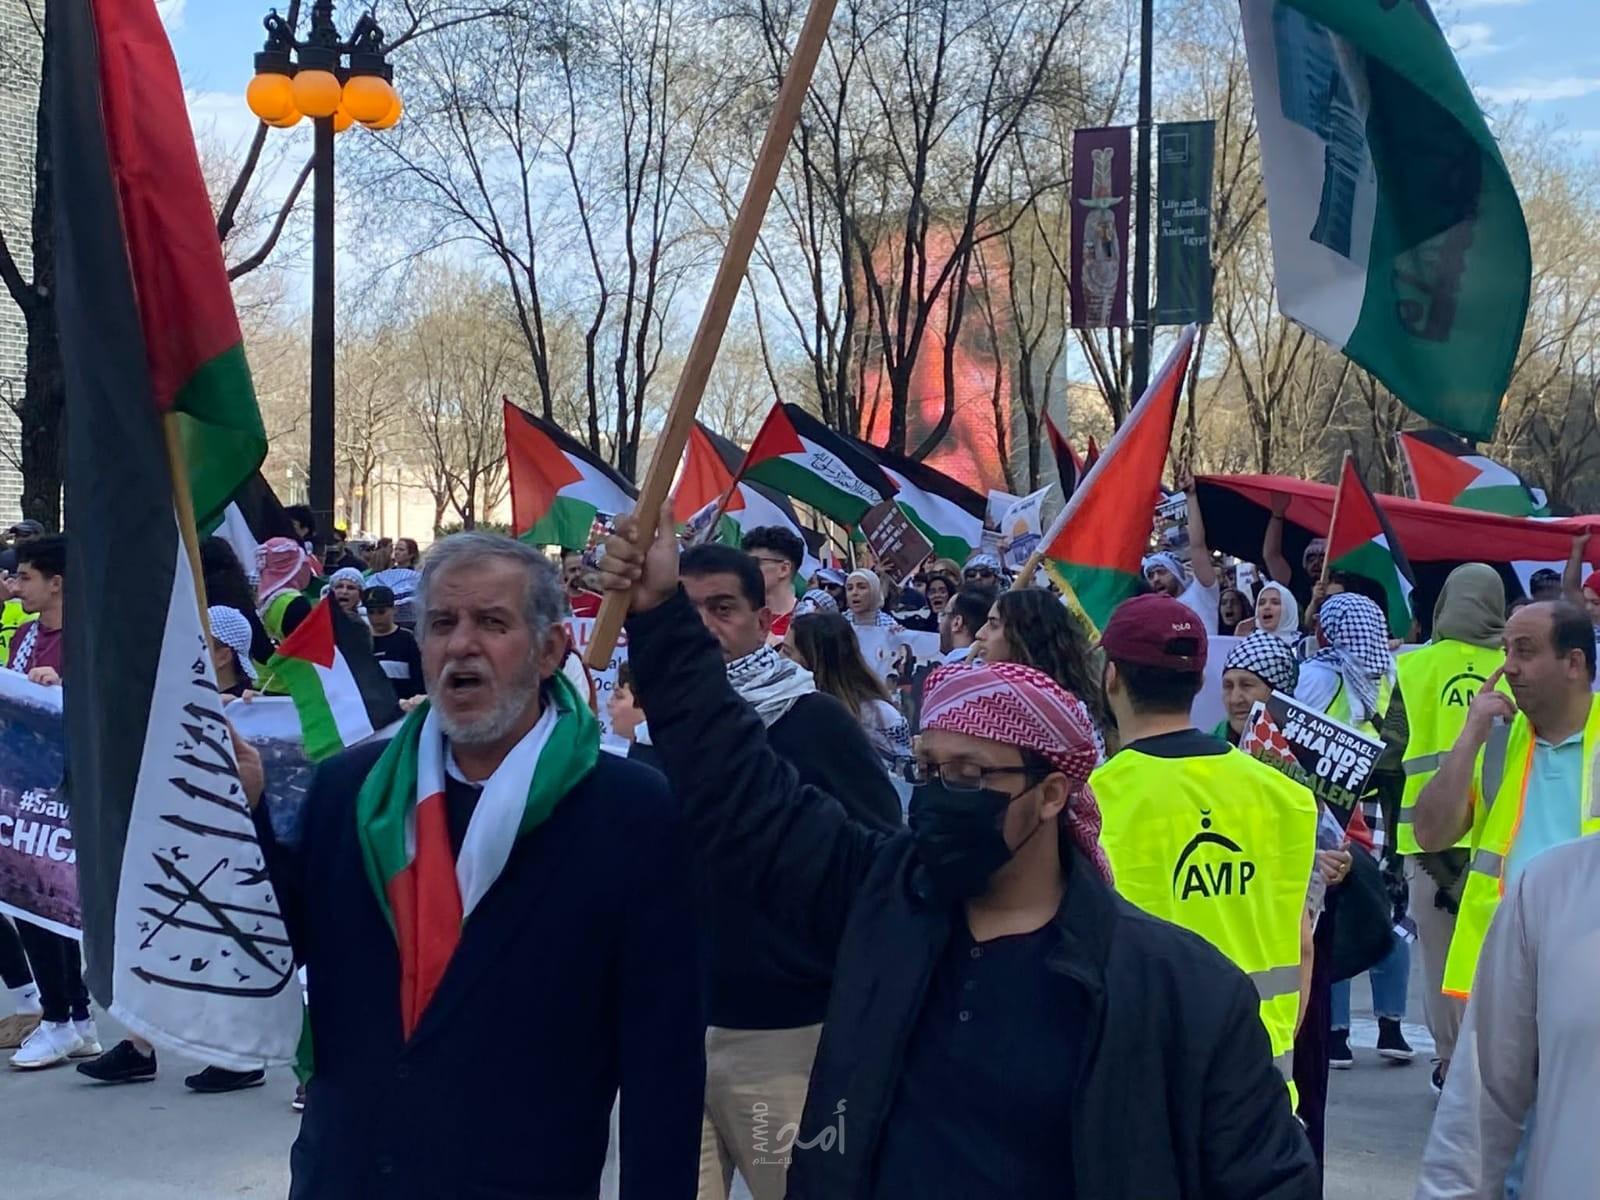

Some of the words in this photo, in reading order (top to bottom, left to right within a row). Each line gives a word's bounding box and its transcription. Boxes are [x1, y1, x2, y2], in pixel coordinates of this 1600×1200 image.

[1281, 720, 1372, 776] #HANDS
[1286, 707, 1307, 726] U.S.
[1309, 719, 1334, 738] AND
[1335, 731, 1377, 758] ISRAEL:
[1315, 757, 1364, 791] OFF
[1181, 861, 1256, 900] AMP
